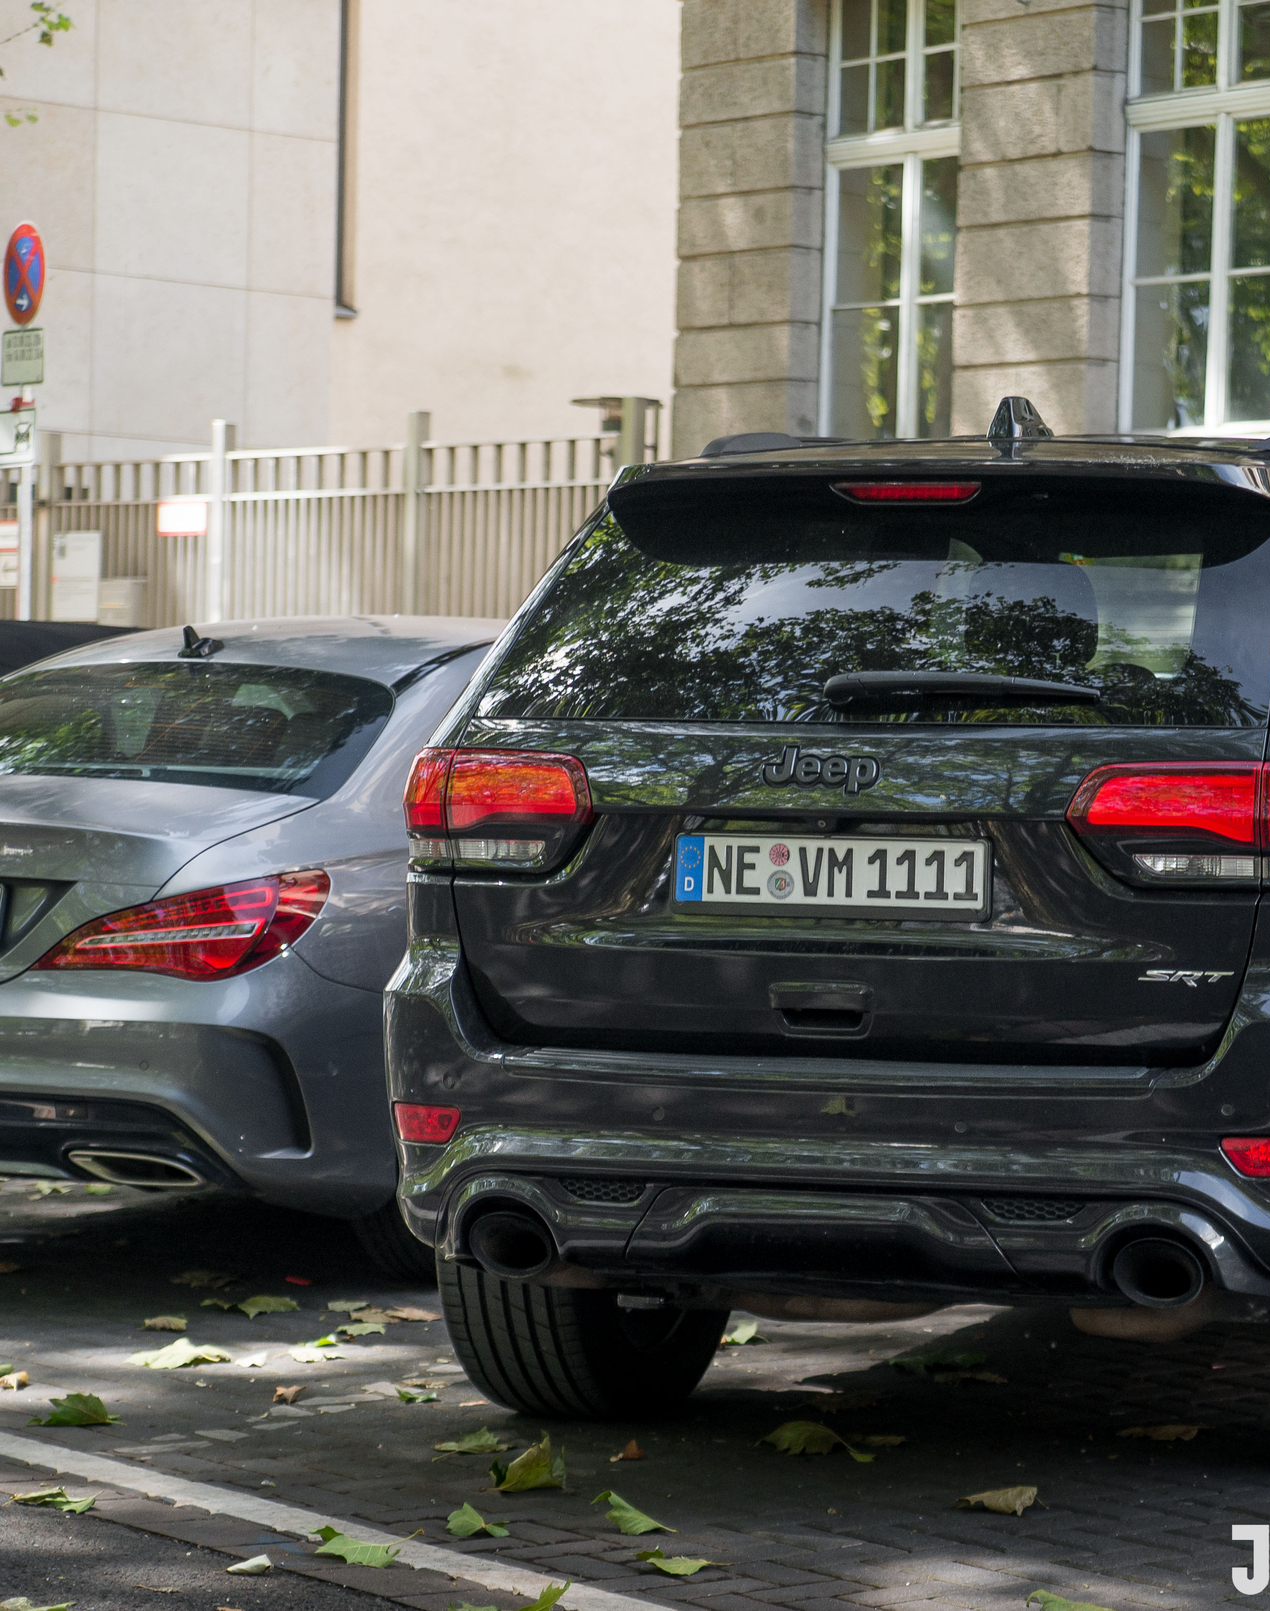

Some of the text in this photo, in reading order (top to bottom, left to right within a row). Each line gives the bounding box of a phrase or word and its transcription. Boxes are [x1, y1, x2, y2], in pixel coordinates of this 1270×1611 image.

[762, 746, 882, 797] Jeep
[683, 876, 695, 892] D
[706, 844, 761, 896] NE
[798, 846, 854, 898] VM
[866, 849, 979, 901] 1111
[1137, 969, 1235, 988] SRT
